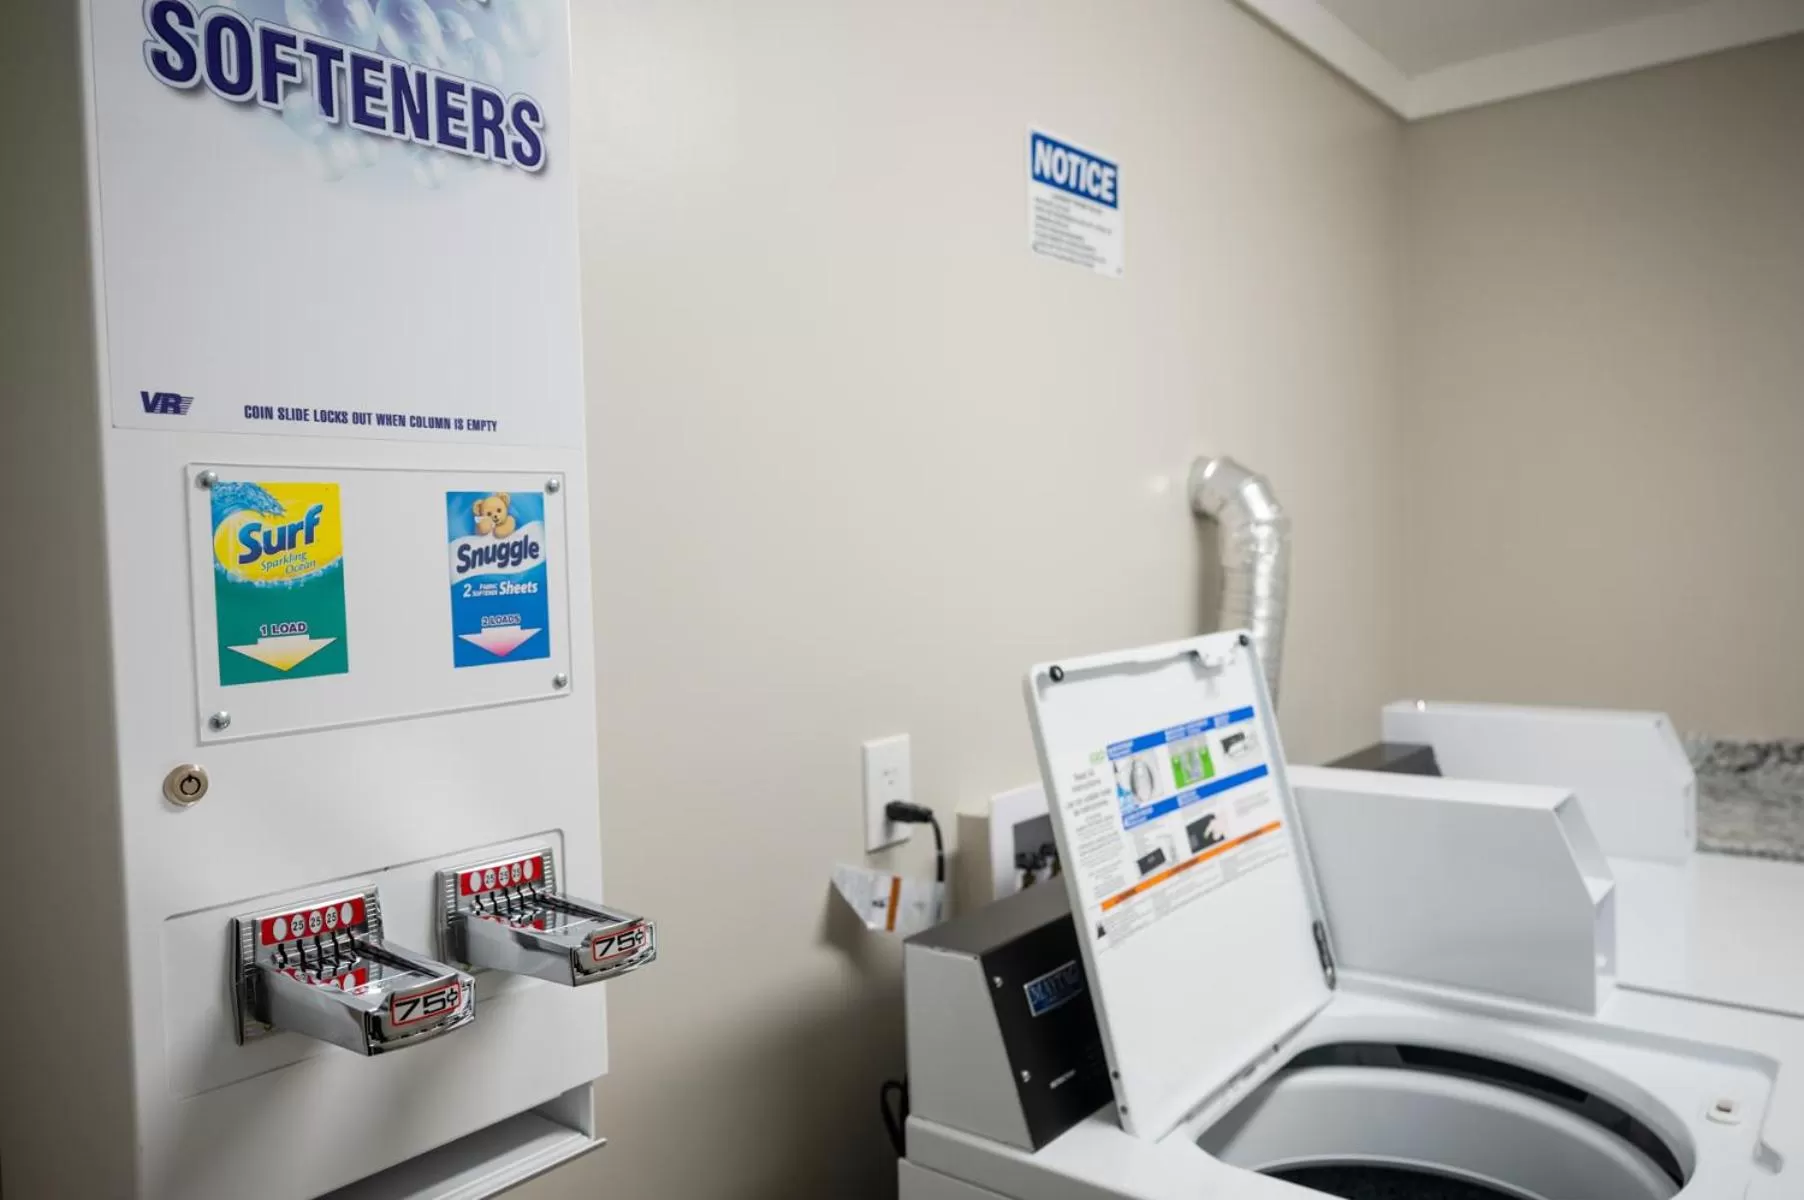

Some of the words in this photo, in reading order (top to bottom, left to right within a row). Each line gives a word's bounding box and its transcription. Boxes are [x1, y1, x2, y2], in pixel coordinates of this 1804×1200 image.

[147, 0, 545, 171] SOFTENERS
[1034, 139, 1116, 202] NOTICE
[244, 404, 274, 420] COIN
[277, 406, 310, 422] SLIDE
[313, 409, 349, 425] LOCKS
[352, 411, 373, 426] OUT
[375, 412, 407, 428] WHEN
[409, 415, 451, 430] COLUMN
[454, 418, 464, 431] IS
[466, 418, 498, 433] EMPTY
[238, 504, 324, 565] Surf
[261, 550, 309, 573] Sparkling
[285, 559, 316, 575] Ocean
[456, 534, 540, 574] Snuggle
[463, 583, 472, 598] 2
[499, 580, 538, 596] Sheets
[260, 624, 268, 636] 1
[271, 621, 307, 635] LOAD
[293, 920, 304, 931] 25
[311, 916, 321, 928] 25
[327, 911, 337, 923] 25
[596, 929, 644, 957] 75¢
[395, 988, 458, 1021] 75¢
